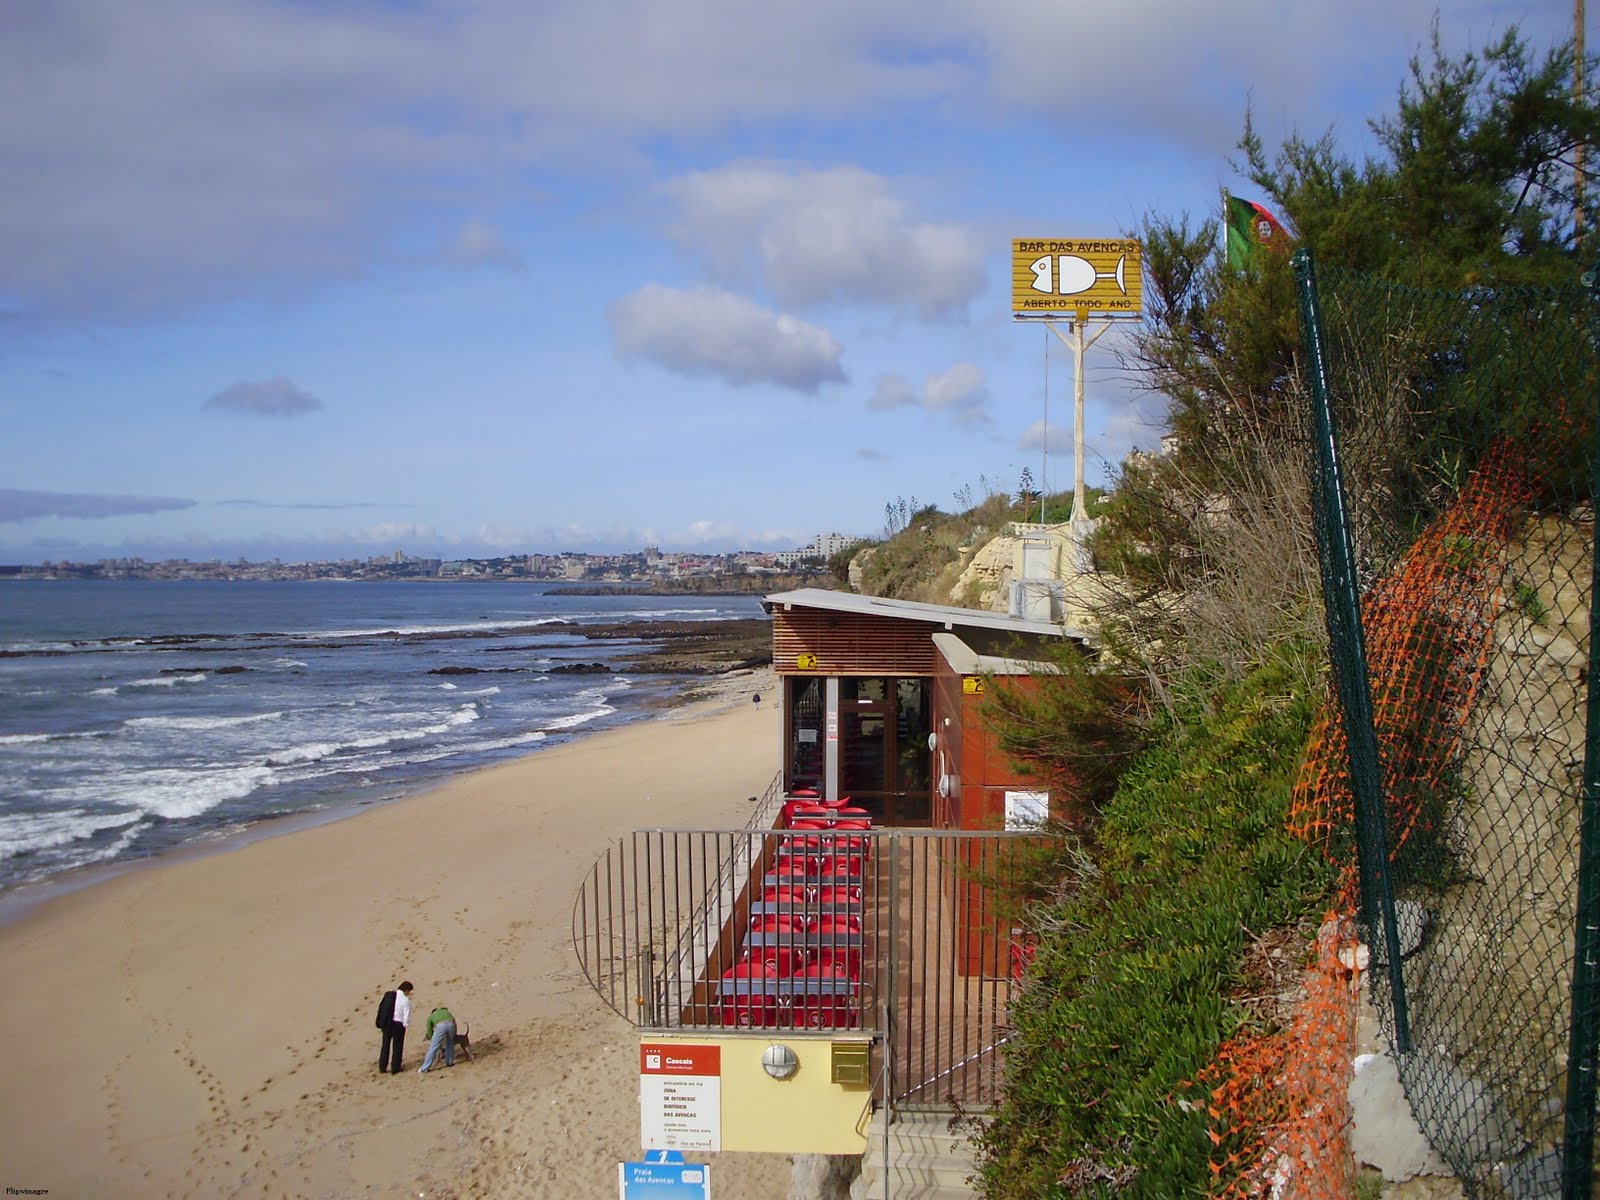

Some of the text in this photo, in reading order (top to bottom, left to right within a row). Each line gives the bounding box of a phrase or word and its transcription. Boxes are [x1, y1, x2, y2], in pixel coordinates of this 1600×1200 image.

[1020, 242, 1135, 253] BAR DAS AVENCAS
[1023, 300, 1132, 309] ABERTO TODO ANO
[634, 1168, 652, 1176] Praia
